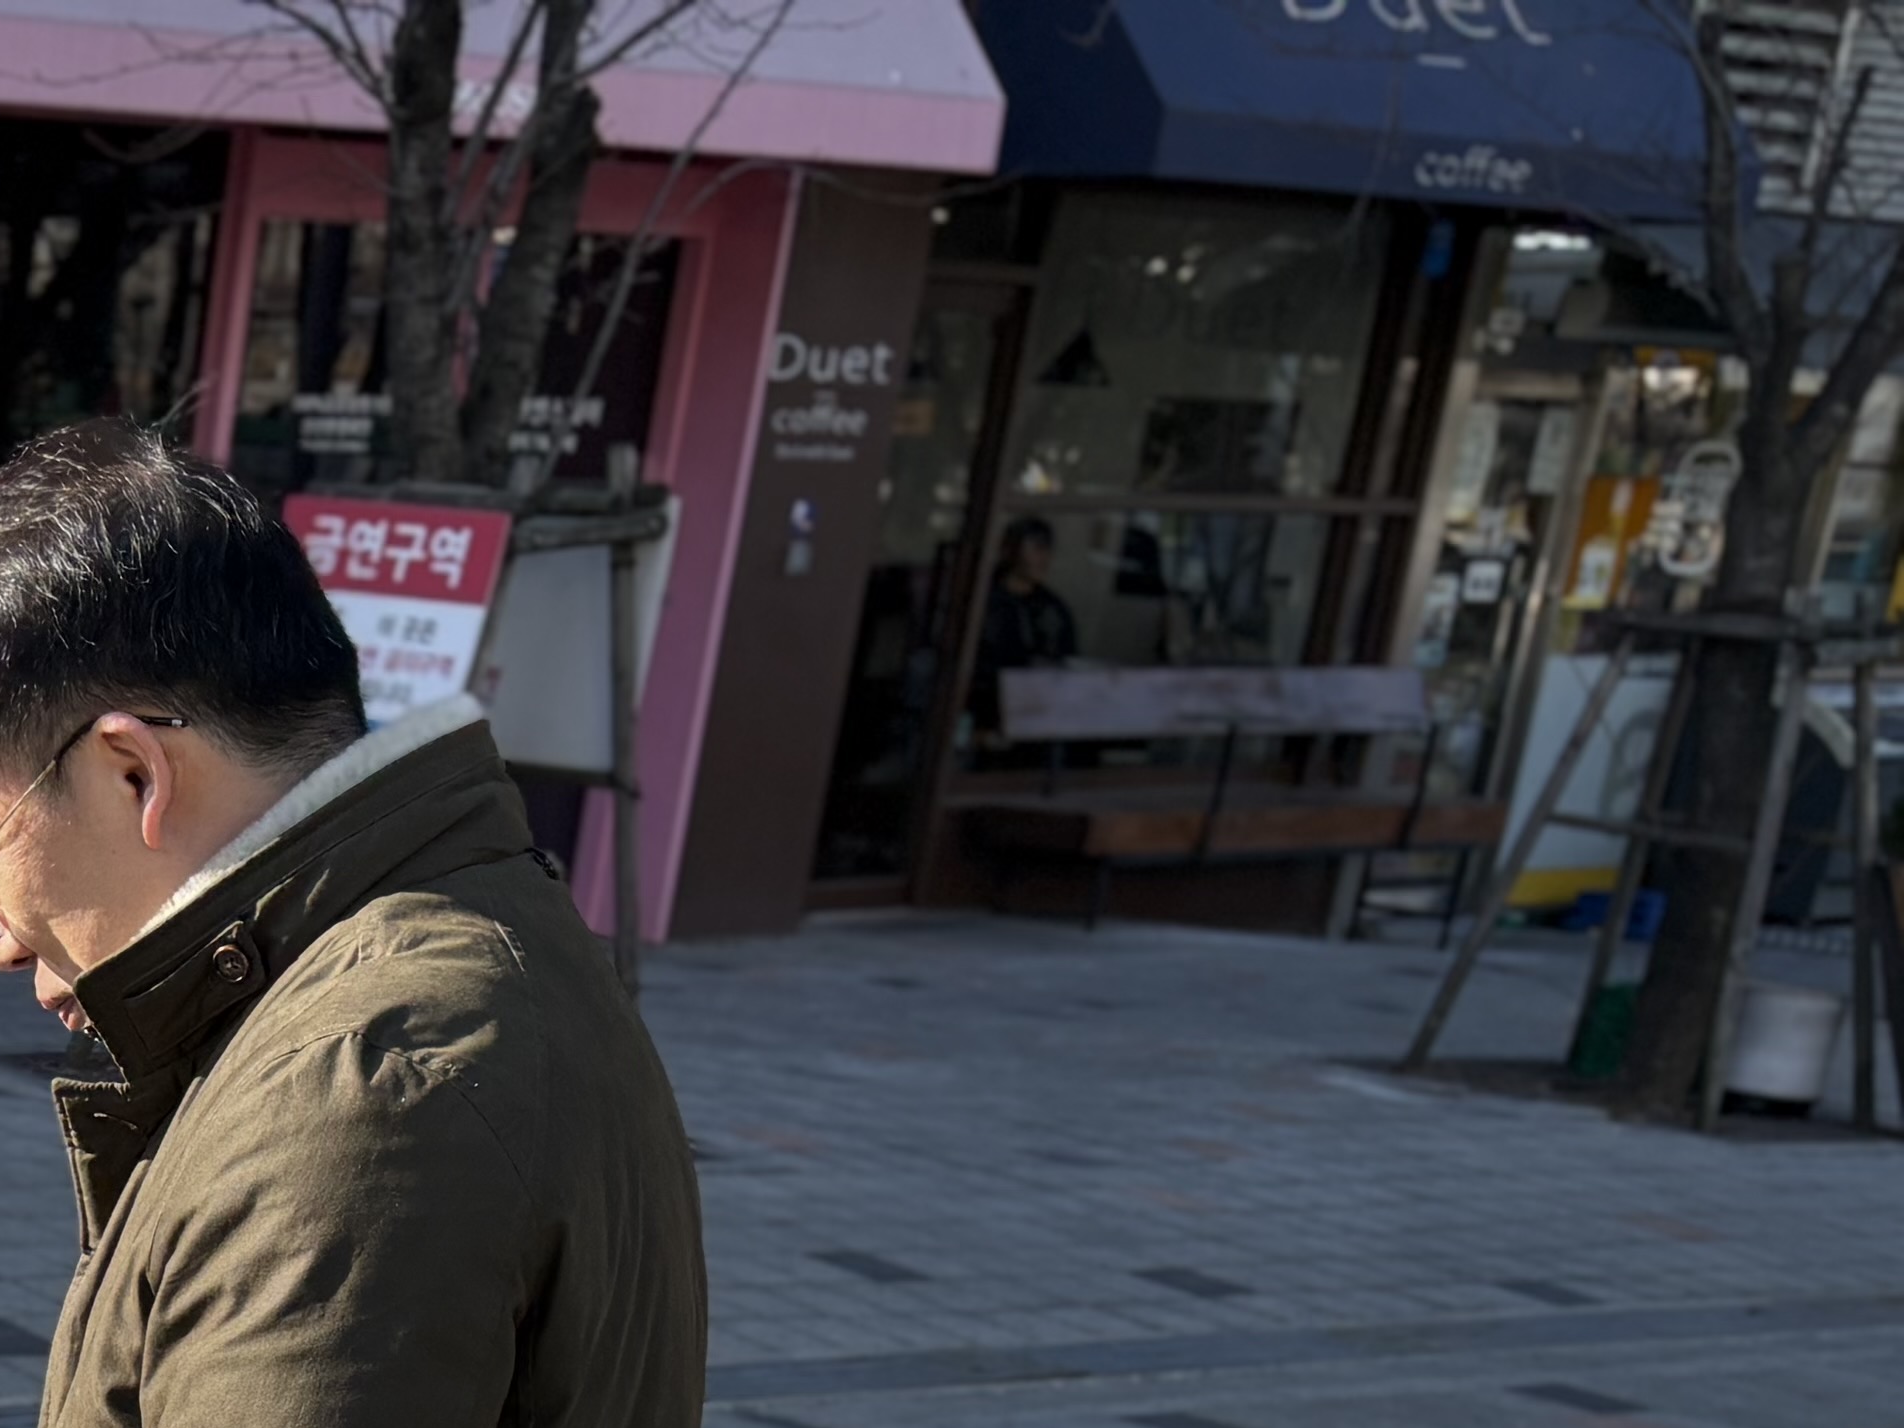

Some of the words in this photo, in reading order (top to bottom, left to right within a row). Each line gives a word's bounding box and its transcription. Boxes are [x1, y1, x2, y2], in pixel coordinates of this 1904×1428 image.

[1414, 145, 1532, 193] coffee
[768, 332, 893, 386] Duet
[304, 513, 473, 590] 금연구역
